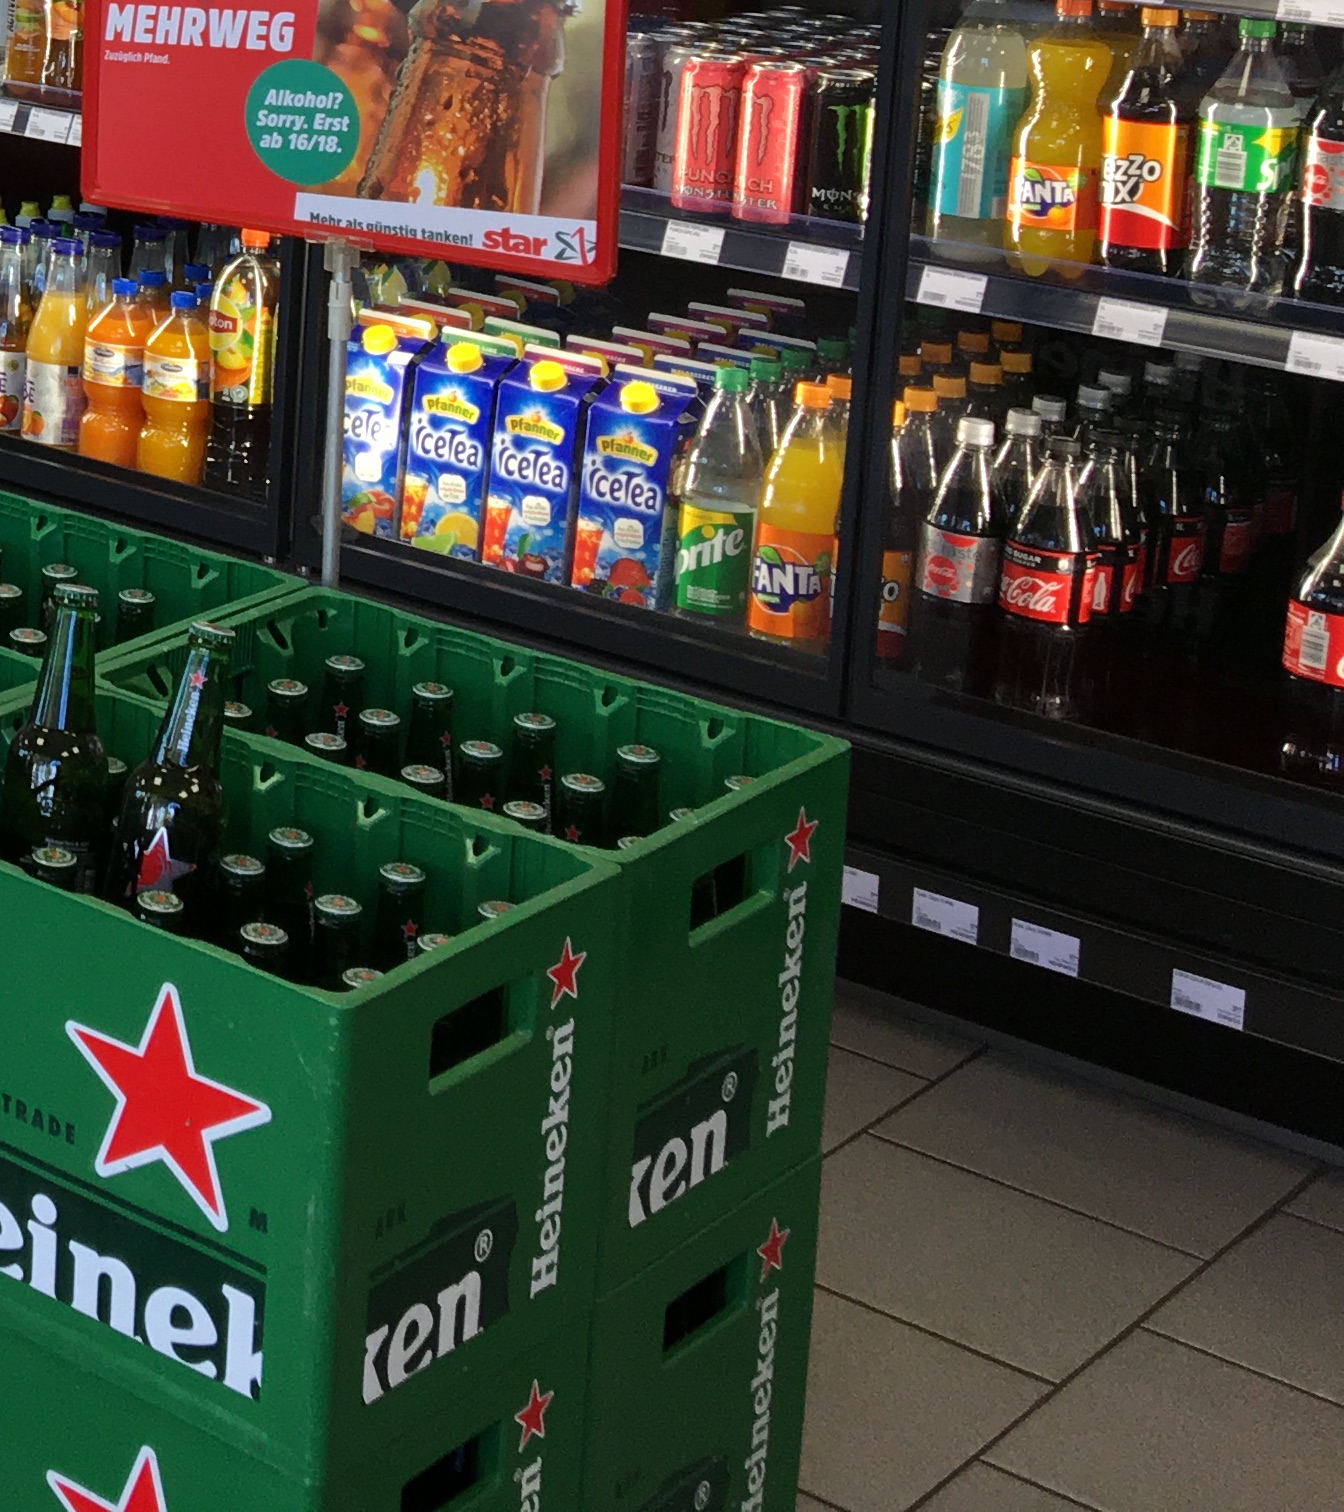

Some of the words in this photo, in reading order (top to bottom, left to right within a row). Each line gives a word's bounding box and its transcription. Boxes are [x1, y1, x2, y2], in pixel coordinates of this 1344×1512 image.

[105, 4, 295, 52] MEHRWEG
[104, 50, 142, 64] Zuzüglich
[144, 52, 171, 65] Pfand.
[264, 89, 344, 109] Alkohol?
[256, 109, 309, 132] Sorry.
[313, 112, 350, 132] Erst
[260, 131, 283, 150] ab
[287, 133, 343, 154] 16/18.
[1015, 179, 1075, 204] FANTA
[309, 210, 343, 227] Mehr
[345, 217, 364, 229] als
[421, 227, 474, 247] tanken!
[482, 227, 548, 257] star
[427, 399, 476, 421] pfanner
[510, 418, 561, 441] pfanner
[601, 438, 654, 463] pfanner
[676, 527, 745, 586] prite
[753, 562, 822, 596] FANTA
[767, 880, 808, 1138] Heineken
[1, 1092, 76, 1146] TRADE
[530, 1017, 575, 1300] Heineken
